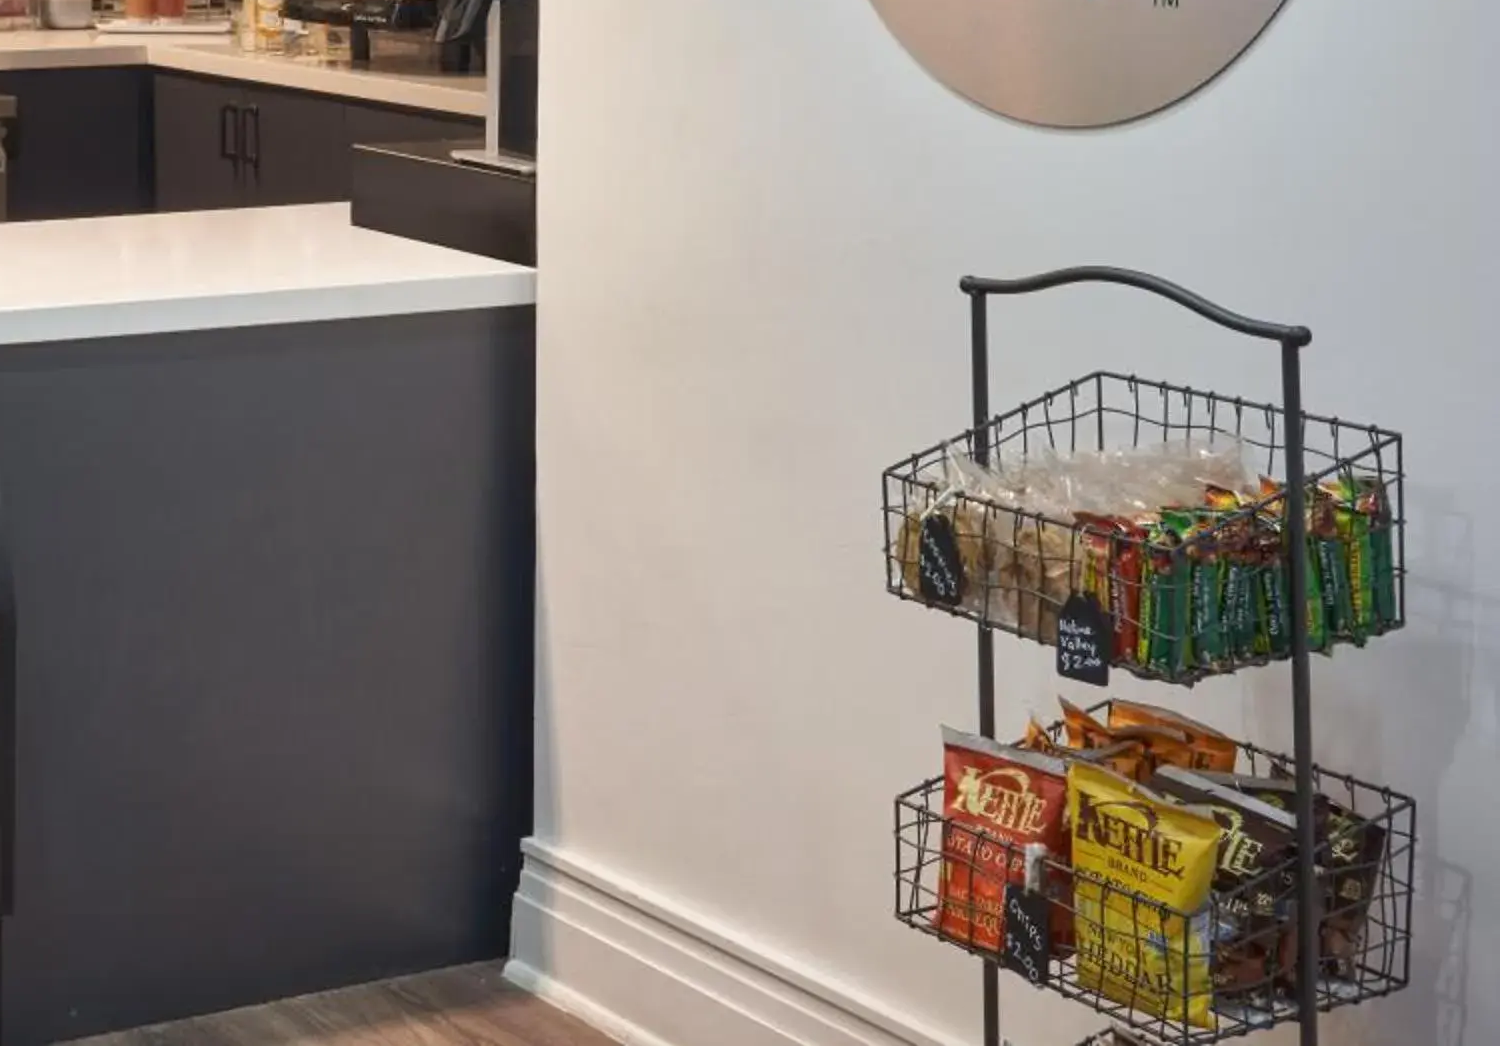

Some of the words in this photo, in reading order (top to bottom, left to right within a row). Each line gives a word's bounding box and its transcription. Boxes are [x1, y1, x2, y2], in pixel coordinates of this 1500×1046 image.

[951, 765, 1048, 834] KETTLE
[1077, 790, 1186, 881] KETTLE
[1107, 856, 1148, 884] BRAND
